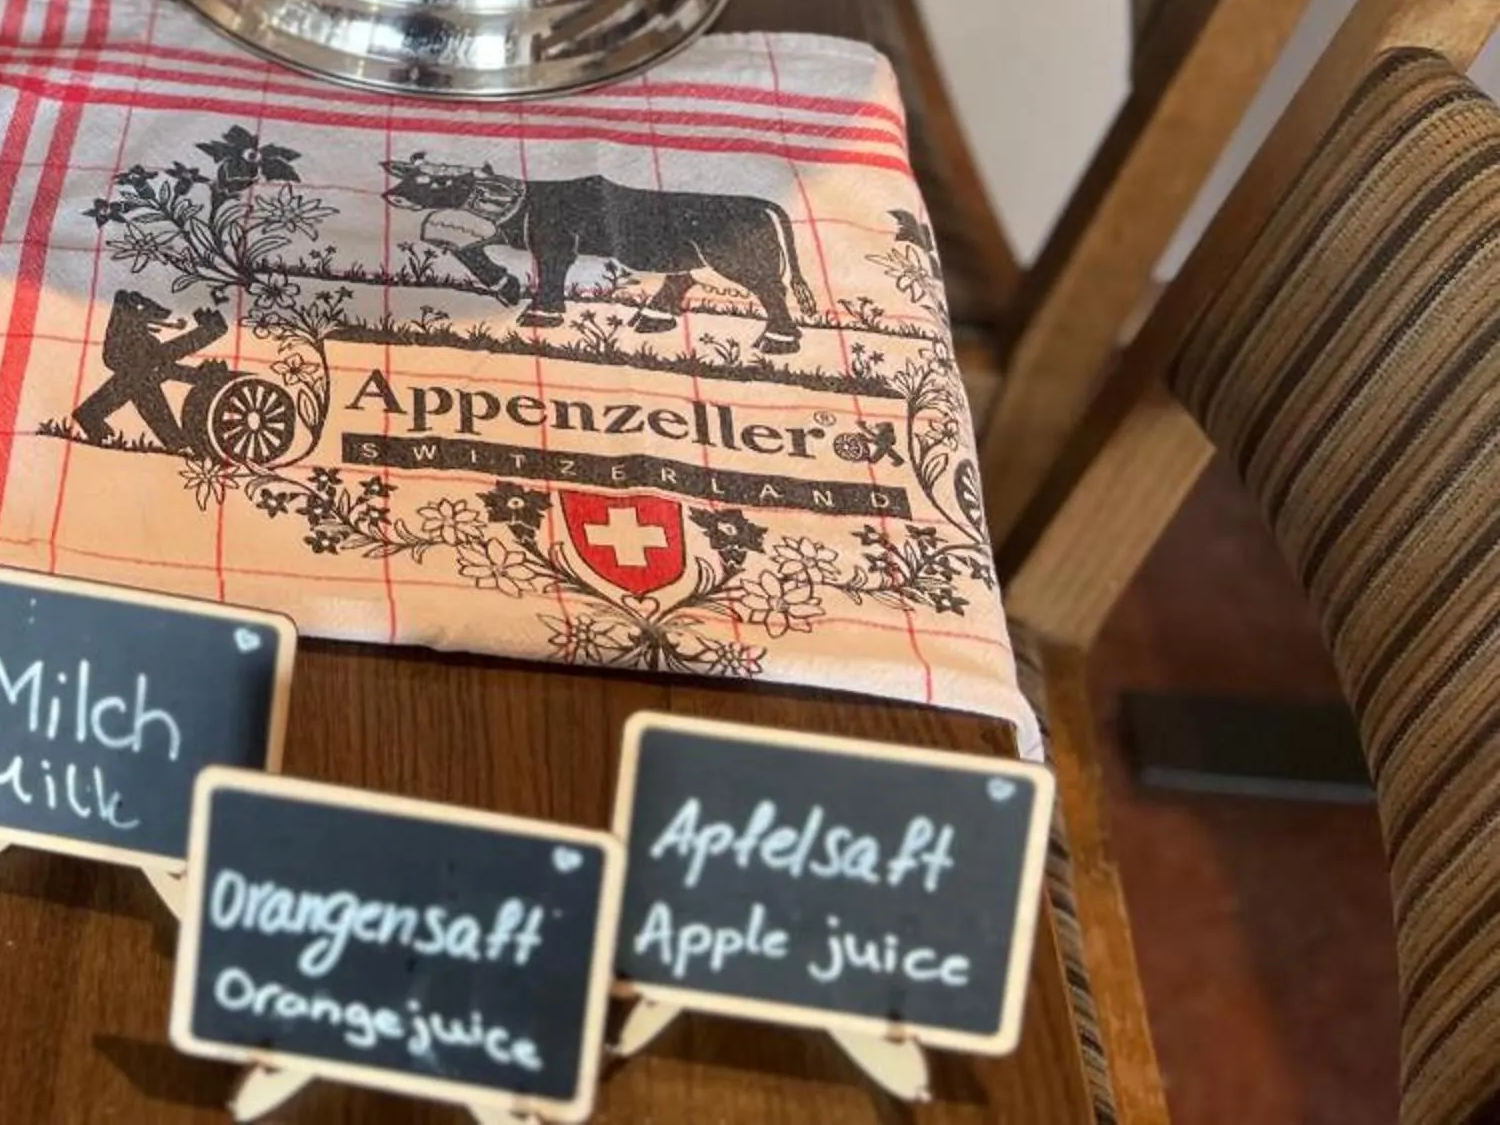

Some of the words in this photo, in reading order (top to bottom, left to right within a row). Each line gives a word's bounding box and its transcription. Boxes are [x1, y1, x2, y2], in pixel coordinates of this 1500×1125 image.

[361, 441, 890, 509] SWITZERLAND
[649, 797, 955, 893] Apfelsaft
[209, 868, 544, 977] Orangensaft
[633, 900, 790, 980] Apple
[808, 914, 970, 986] juice
